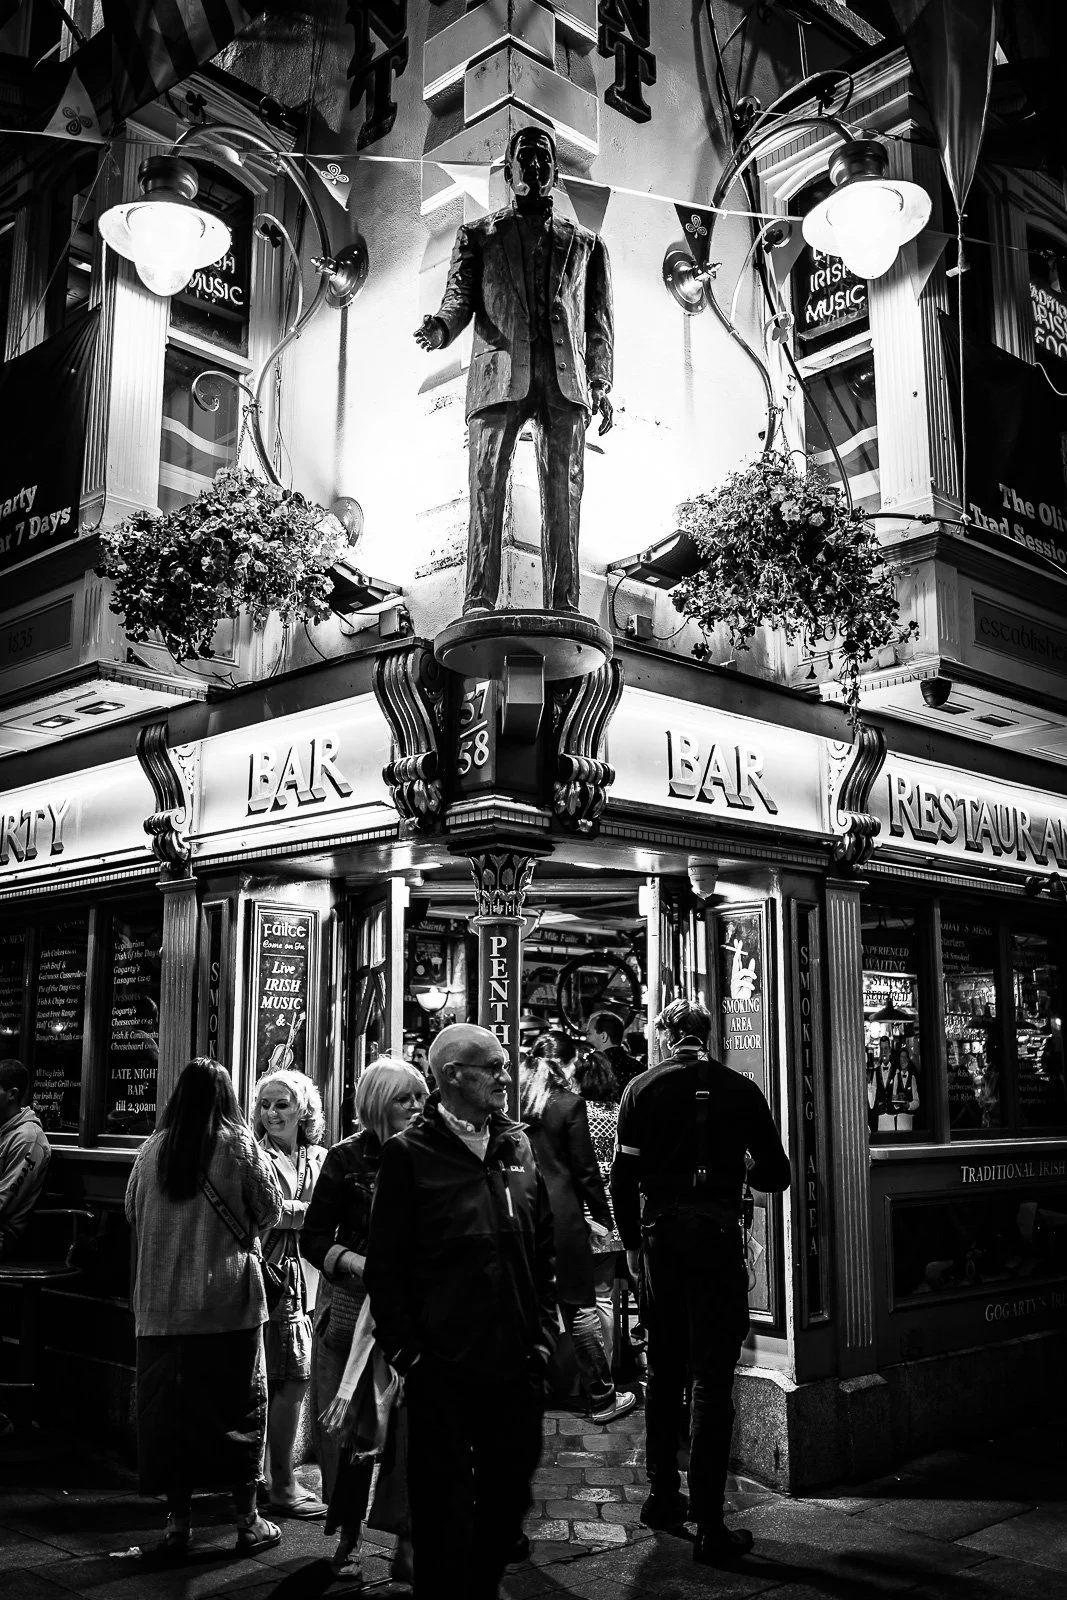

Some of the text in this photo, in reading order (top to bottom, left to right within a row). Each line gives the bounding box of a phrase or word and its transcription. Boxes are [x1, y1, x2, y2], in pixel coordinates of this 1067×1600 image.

[188, 271, 244, 306] MUSIC
[805, 284, 866, 324] MUSIC
[998, 482, 1036, 521] The
[15, 521, 25, 546] 7
[29, 506, 72, 540] Days
[969, 502, 1010, 539] Trad
[245, 733, 354, 818] BAR
[665, 730, 779, 815] BAR
[262, 940, 283, 950] Come
[284, 943, 293, 951] on
[114, 948, 157, 961] Dish of the Day
[113, 963, 141, 976] Gogarty's
[271, 960, 296, 975] Live
[864, 956, 907, 973] WAITING
[113, 976, 137, 986] Lasagne
[264, 977, 302, 993] IRISH
[260, 995, 303, 1011] MUSIC
[722, 998, 760, 1015] SMOKING
[112, 1005, 137, 1017] Gogarty's
[112, 1017, 141, 1027] Cheesecake
[275, 1013, 286, 1028] &
[730, 1017, 753, 1032] AREA
[112, 1031, 125, 1040] Irish
[734, 1034, 762, 1050] FLOOR
[111, 1041, 144, 1051] Cheeseboard
[111, 1068, 132, 1080] LATE
[127, 1084, 145, 1096] BAR
[115, 1100, 156, 1113] till 2.30am
[799, 945, 821, 1259] SMOKING AREA
[960, 1160, 1067, 1183] TRADITIONAL IRISH
